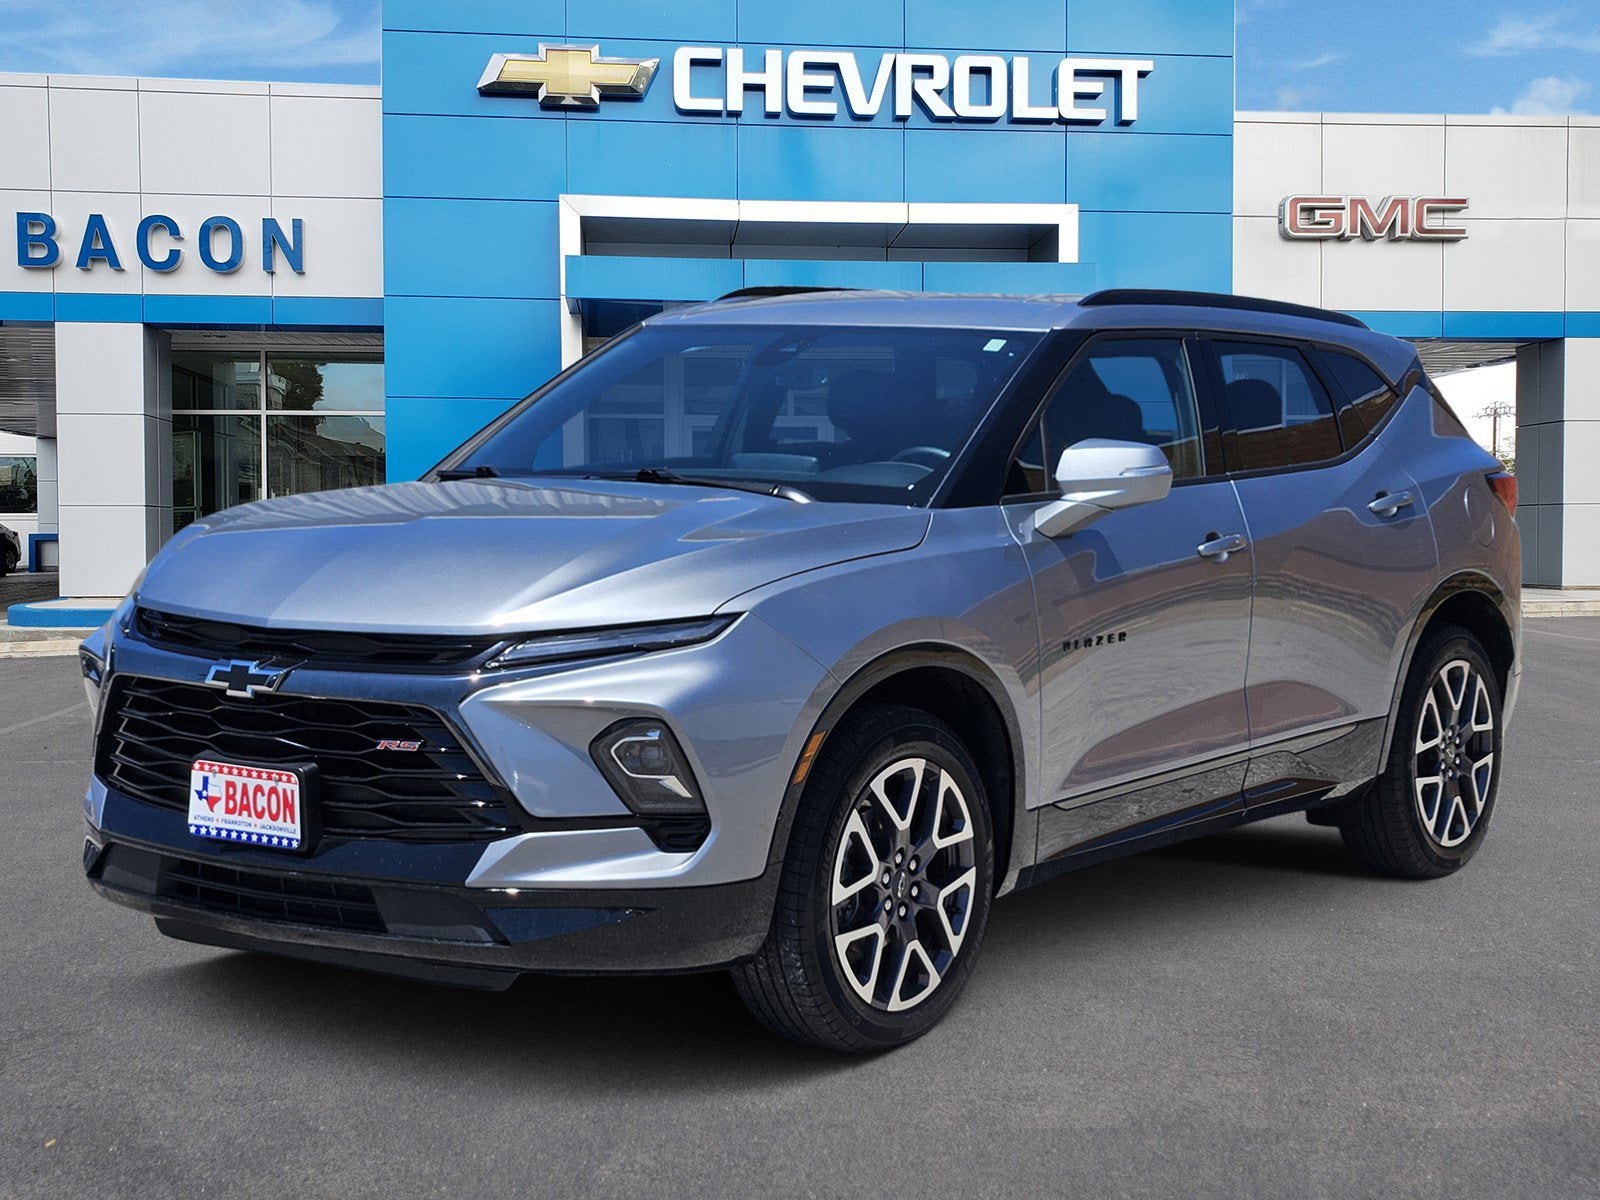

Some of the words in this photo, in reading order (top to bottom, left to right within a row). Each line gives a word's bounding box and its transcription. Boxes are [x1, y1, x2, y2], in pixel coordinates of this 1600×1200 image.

[673, 46, 1154, 126] CHEVROLET
[1278, 194, 1469, 241] GMC
[16, 211, 306, 275] BACON
[1062, 631, 1127, 652] BLAZER
[376, 739, 421, 751] RS
[224, 780, 296, 824] BACON
[193, 814, 214, 823] ATHENS
[220, 818, 252, 828] FRANKSTON
[259, 824, 296, 835] JACKSONVILLE
